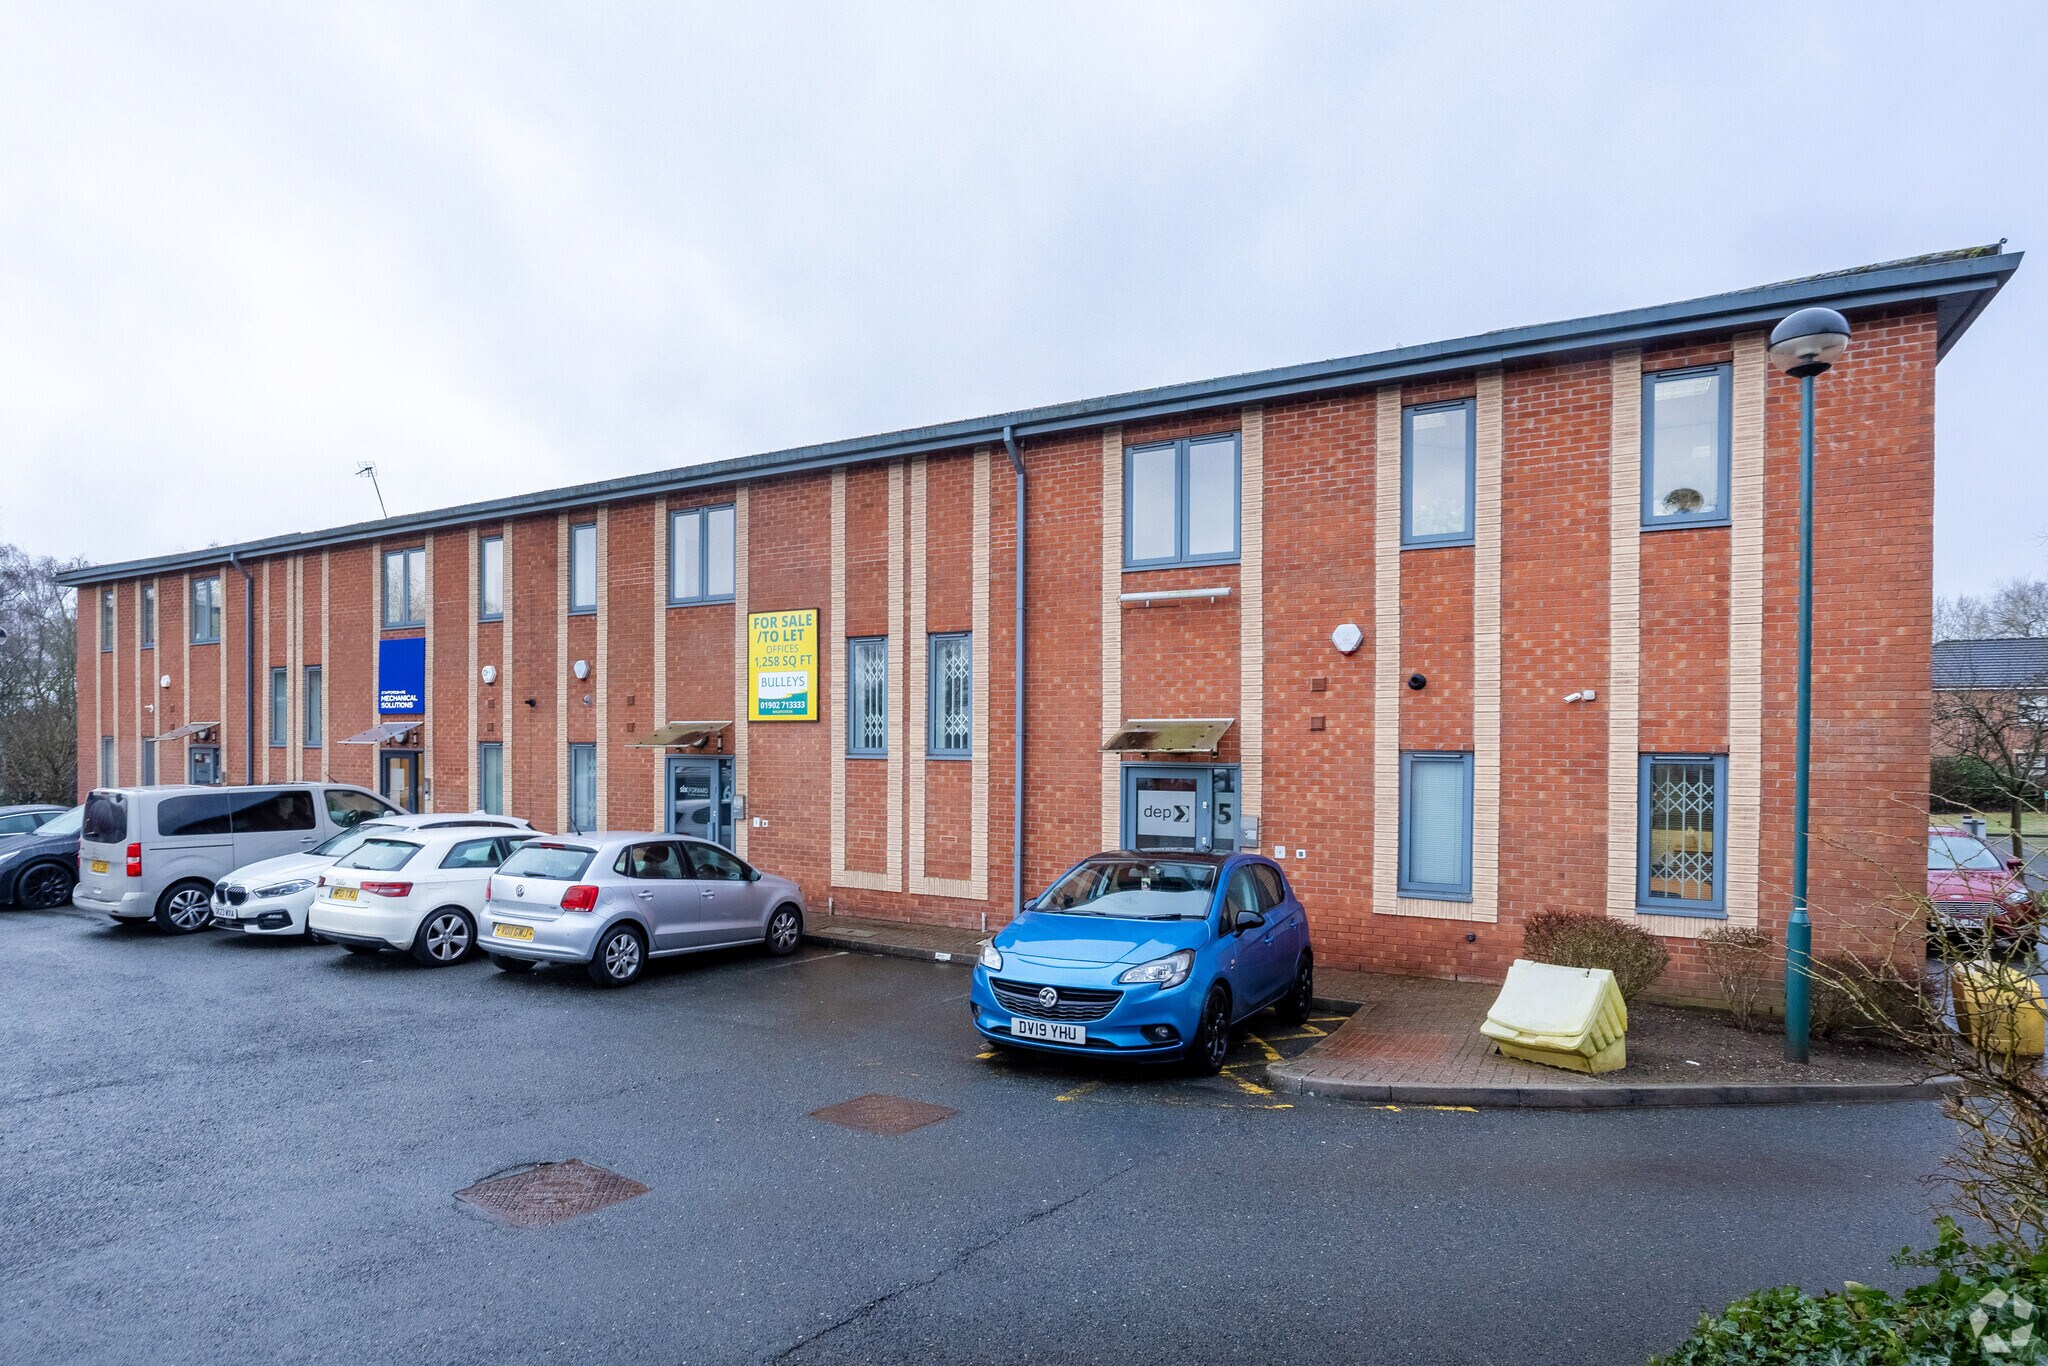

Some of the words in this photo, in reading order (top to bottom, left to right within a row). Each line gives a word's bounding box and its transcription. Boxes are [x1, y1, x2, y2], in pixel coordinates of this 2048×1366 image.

[753, 617, 778, 629] FOR
[781, 614, 812, 628] SALE
[757, 630, 779, 643] /TO
[783, 629, 805, 642] LET
[766, 644, 799, 654] OFFICES
[754, 657, 780, 668] 1,258
[782, 655, 797, 668] SQ
[800, 655, 812, 666] FT
[761, 676, 805, 688] BULLEYS
[760, 701, 780, 709] 01902
[781, 700, 806, 709] 713333
[1143, 805, 1172, 821] dep
[1217, 803, 1232, 825] 5
[1019, 1020, 1047, 1037] DV19
[1050, 1024, 1077, 1041] YHU
